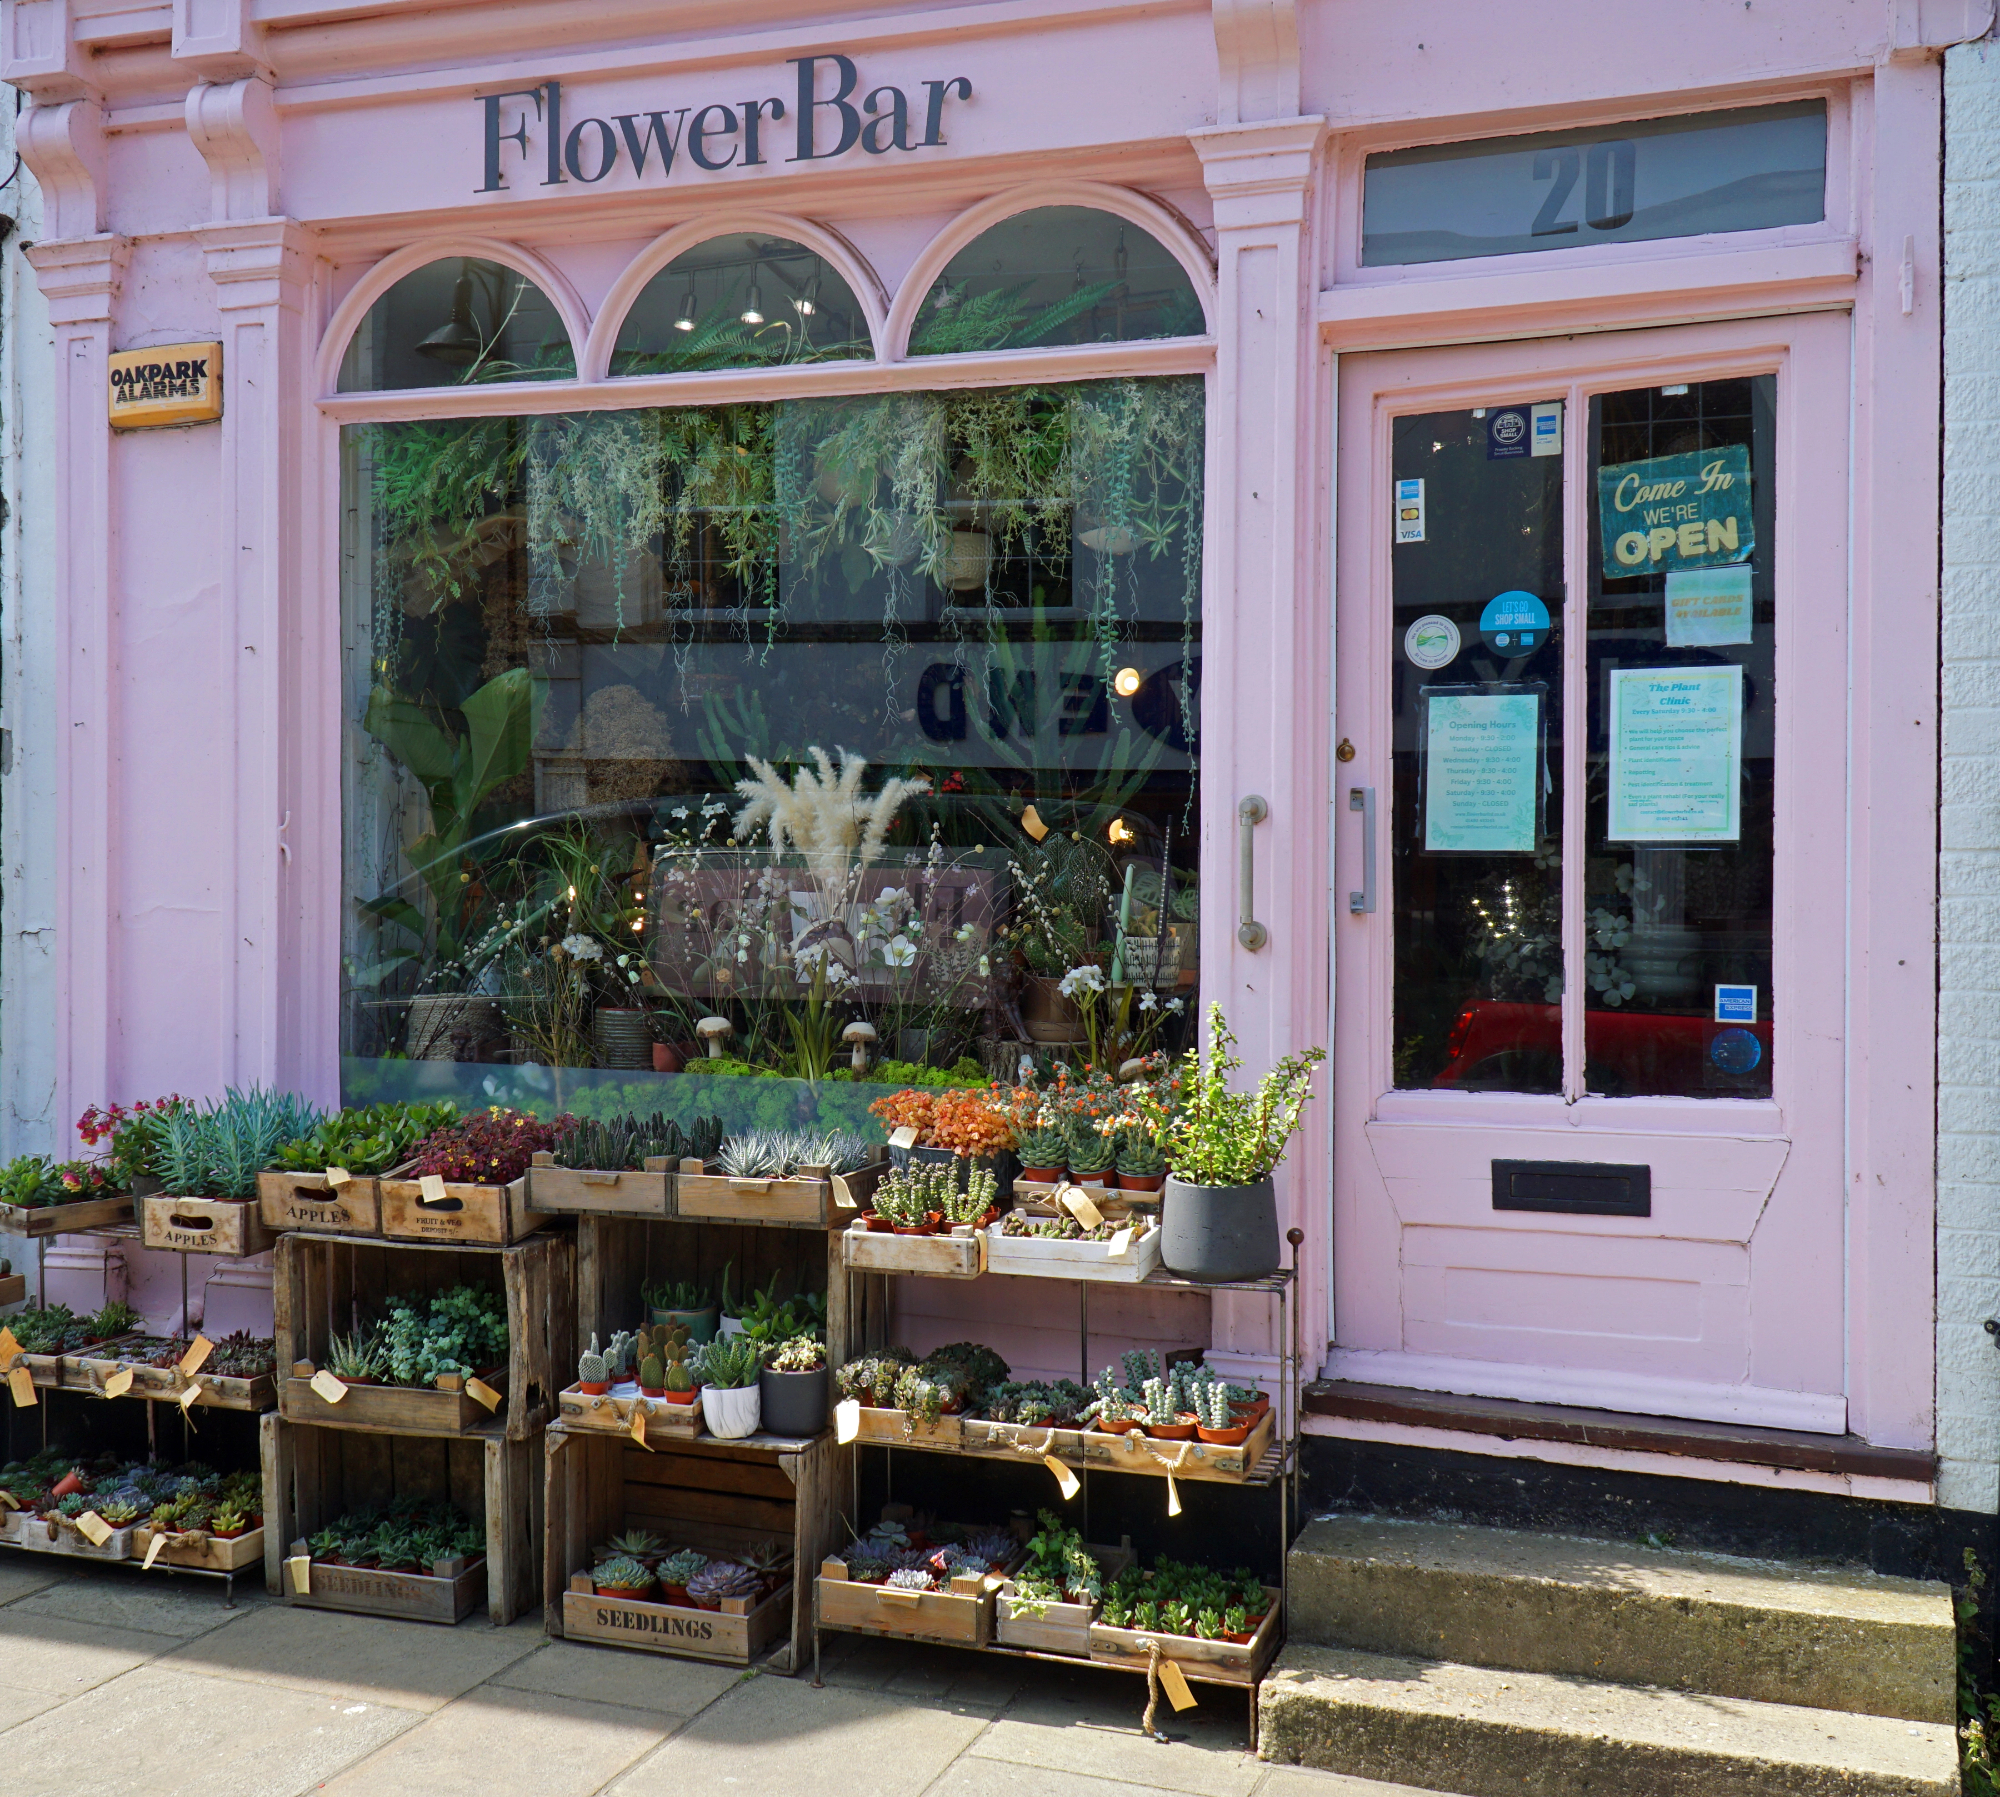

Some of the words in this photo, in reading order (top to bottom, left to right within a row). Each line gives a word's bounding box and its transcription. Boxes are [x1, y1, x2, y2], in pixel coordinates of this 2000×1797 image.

[1531, 138, 1636, 237] 20
[111, 359, 208, 386] OAKPARK
[116, 378, 200, 403] ALARMS
[1614, 472, 1686, 512] Come
[1694, 460, 1736, 495] In
[1643, 503, 1698, 525] WE'RE
[1400, 530, 1422, 538] VISA
[1615, 516, 1739, 565] OPEN
[1502, 601, 1518, 613] LET'S
[1519, 600, 1528, 612] GO
[1672, 597, 1700, 608] GIFT
[1703, 594, 1744, 606] CARDS
[1495, 614, 1513, 625] SHOP
[1514, 612, 1536, 624] SMALL
[1674, 606, 1742, 619] AVAILABLE
[1649, 684, 1669, 692] The
[1671, 683, 1701, 691] Plant
[1660, 697, 1691, 705] Clinic
[1449, 721, 1487, 730] Opening
[1490, 720, 1516, 728] Hours
[286, 1206, 350, 1222] APPLES
[164, 1231, 218, 1246] APPLES
[596, 1608, 712, 1640] SEEDLINGS
